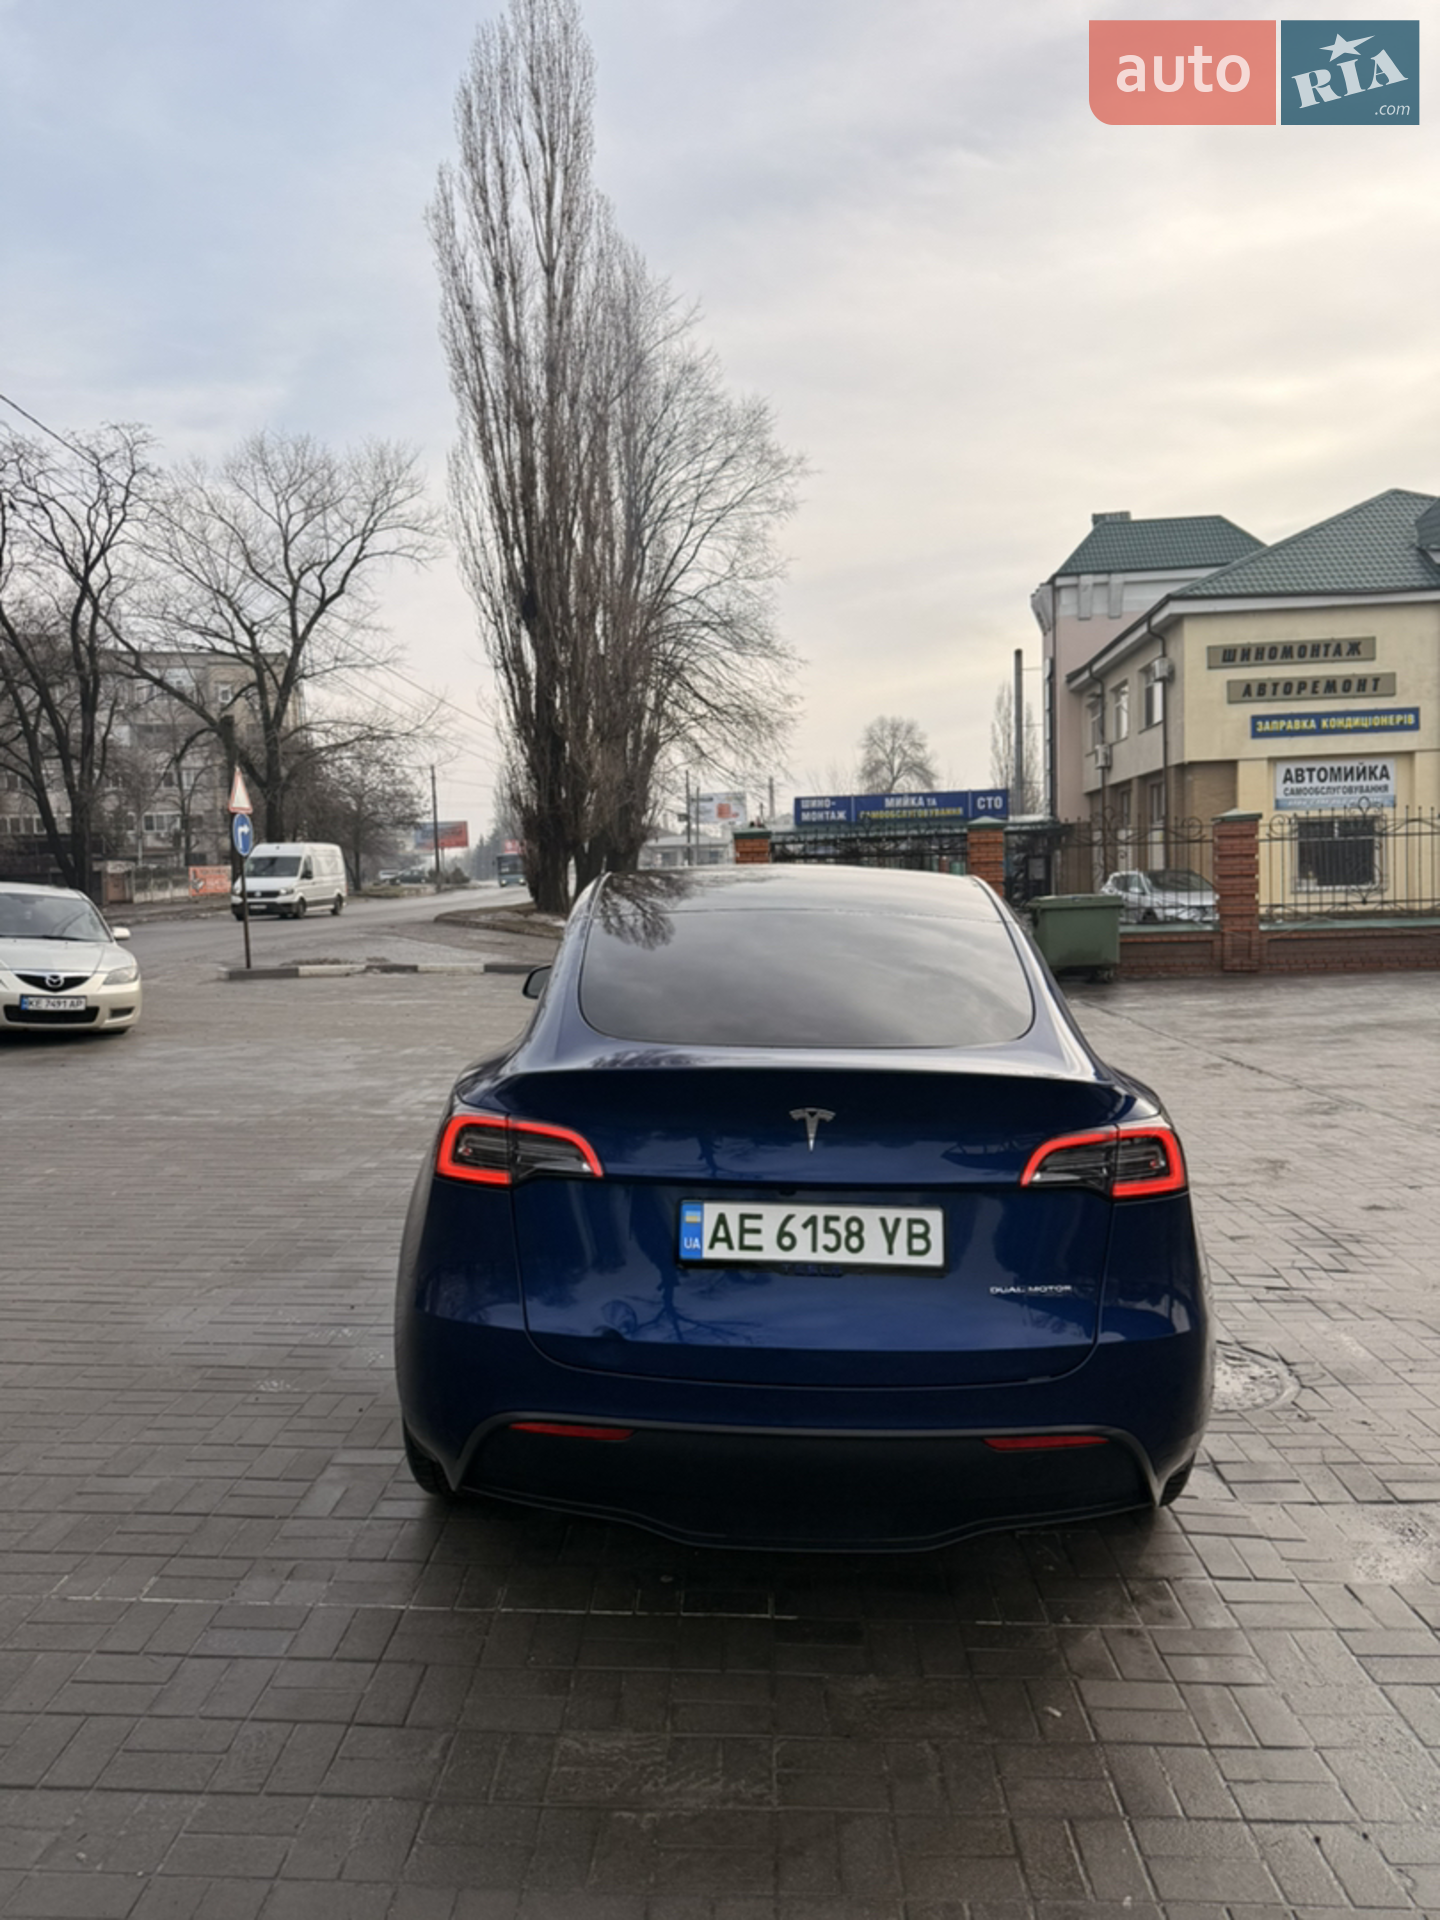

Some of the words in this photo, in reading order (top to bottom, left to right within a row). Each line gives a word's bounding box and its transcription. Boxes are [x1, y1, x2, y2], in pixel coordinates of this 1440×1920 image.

[1221, 641, 1362, 663] ШИНОМОНТАЖ
[1242, 677, 1381, 698] АВТОРЕМОНТ
[1256, 718, 1317, 732] ЗАПРАВКА
[1320, 714, 1415, 730] КОНДИЦІОНЕРІВ
[1282, 762, 1390, 784] АВТОМИЙКА
[1283, 784, 1389, 797] САМООБСЛУГОВУВАННЯ
[884, 795, 925, 808] МИЙКА
[976, 796, 1003, 810] СТО
[801, 810, 847, 822] МОНТАЖ
[708, 1212, 763, 1251] AE
[776, 1213, 865, 1254] 6158
[879, 1216, 932, 1257] YB
[684, 1237, 701, 1249] UA
[989, 1286, 1026, 1295] DUAL
[1028, 1285, 1072, 1293] MOTOR
